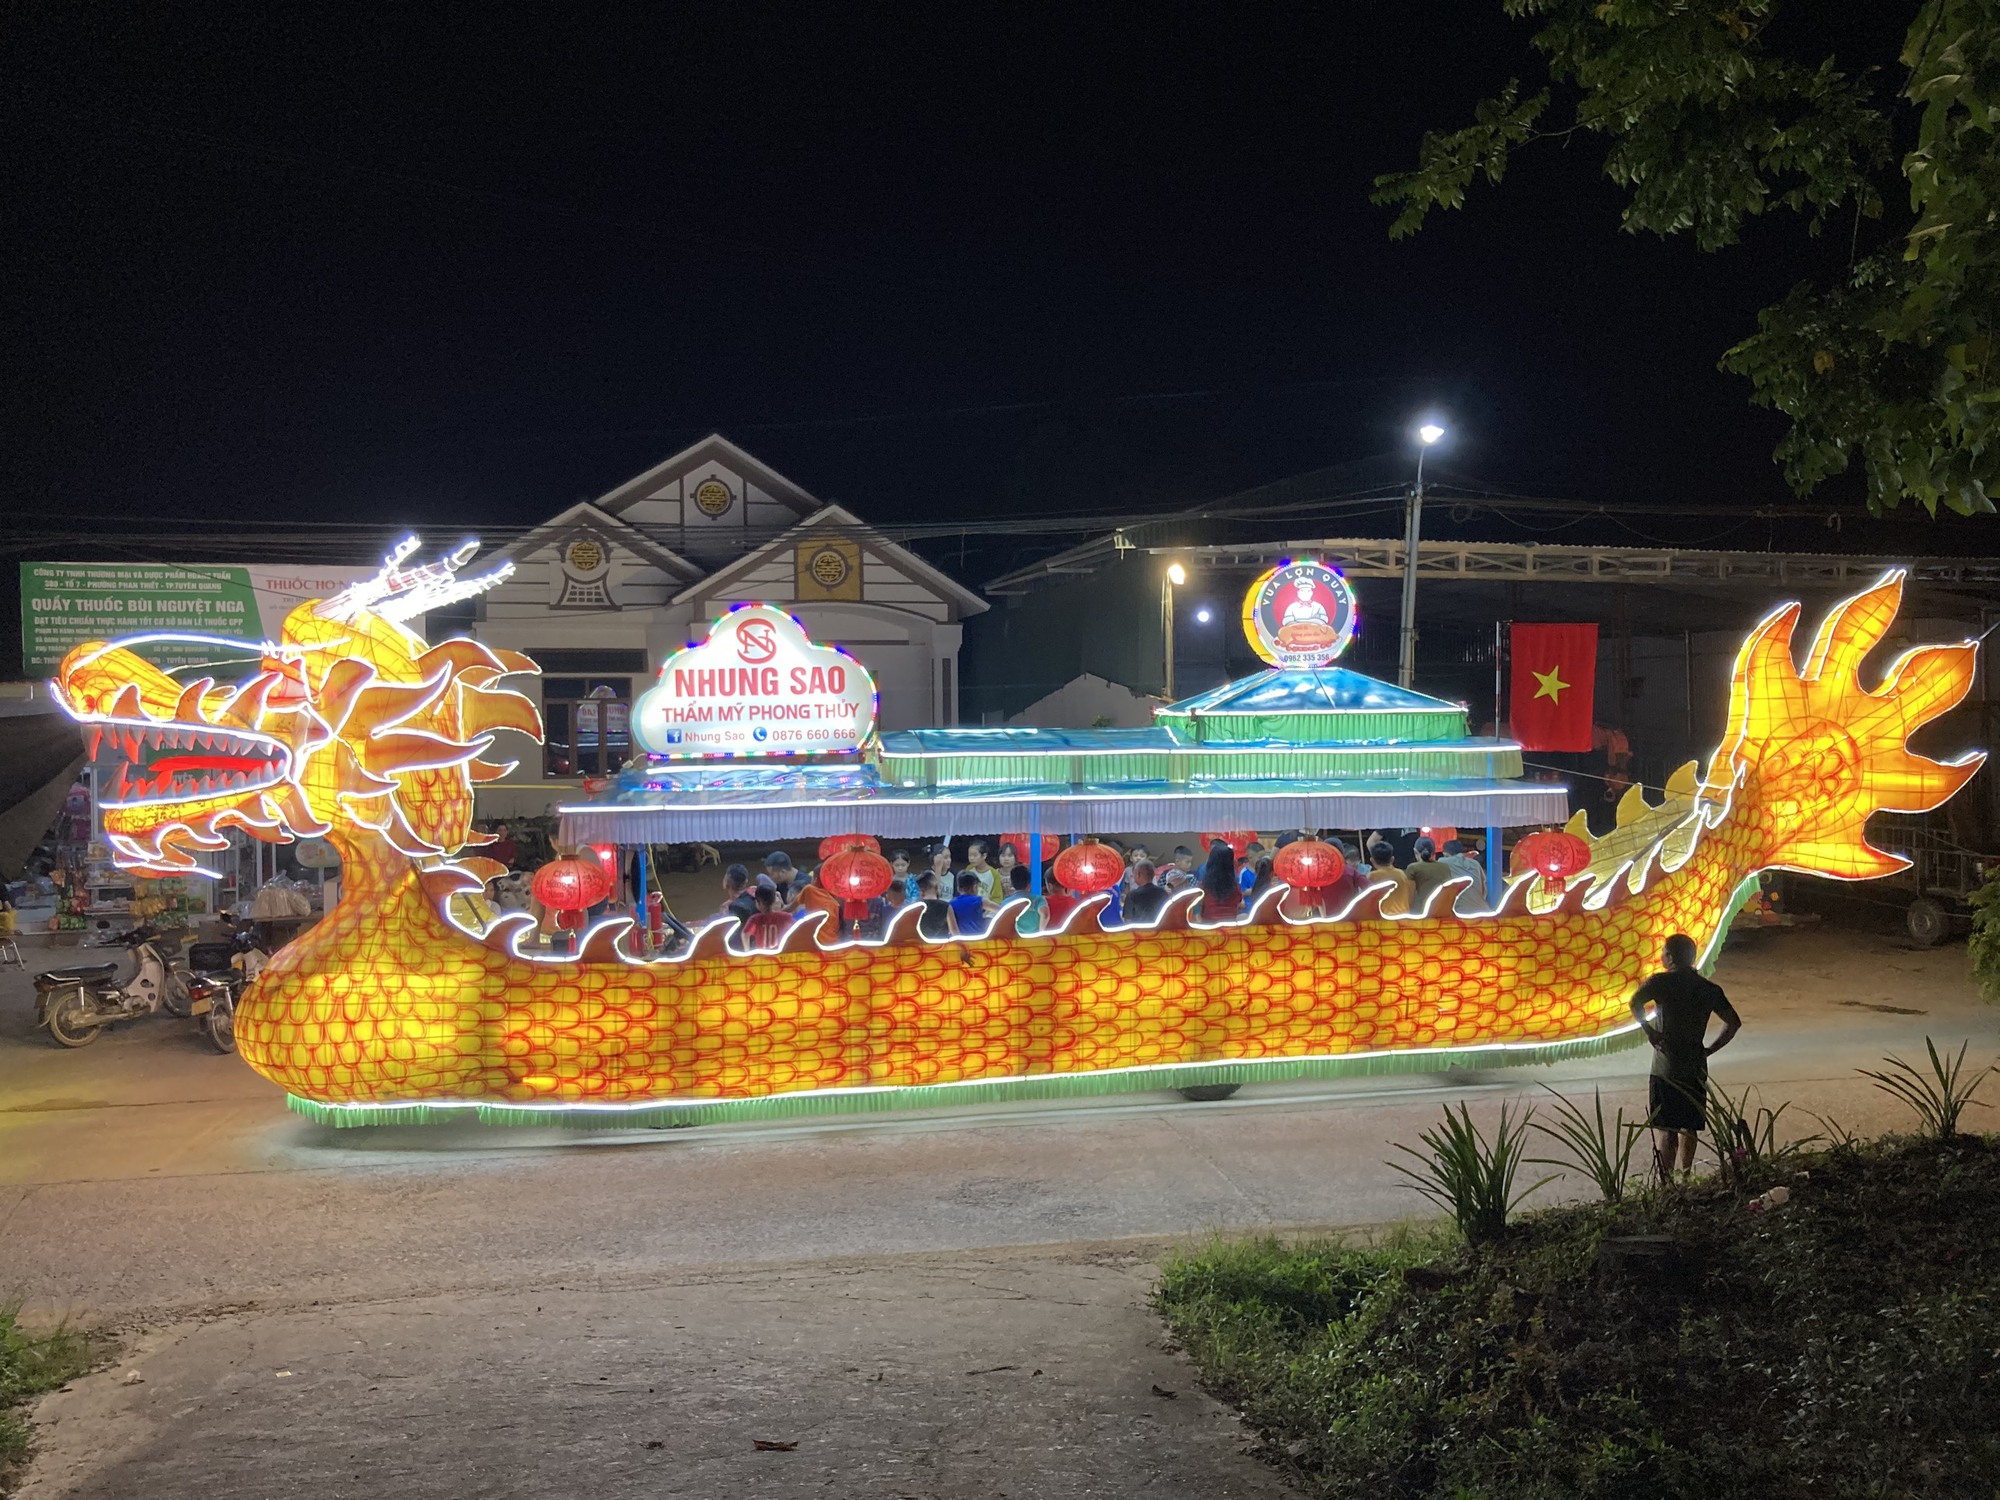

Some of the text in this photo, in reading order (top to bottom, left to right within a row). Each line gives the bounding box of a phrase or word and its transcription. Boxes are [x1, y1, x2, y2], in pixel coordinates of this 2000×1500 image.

[267, 576, 312, 590] THUỐC
[1262, 581, 1281, 606] VUA
[1322, 574, 1347, 605] QUAY
[75, 595, 123, 611] THUỐC
[128, 597, 152, 612] BÙI
[157, 597, 212, 615] NGUYỆT
[215, 600, 245, 613] NGA
[674, 665, 846, 698] NHUNG SAO
[661, 698, 860, 723] THẨM MỸ PHONG THỦY
[685, 731, 721, 743] Nhung
[724, 731, 745, 741] Sao
[772, 728, 856, 741] 0876 660 666
[762, 924, 779, 949] 10
